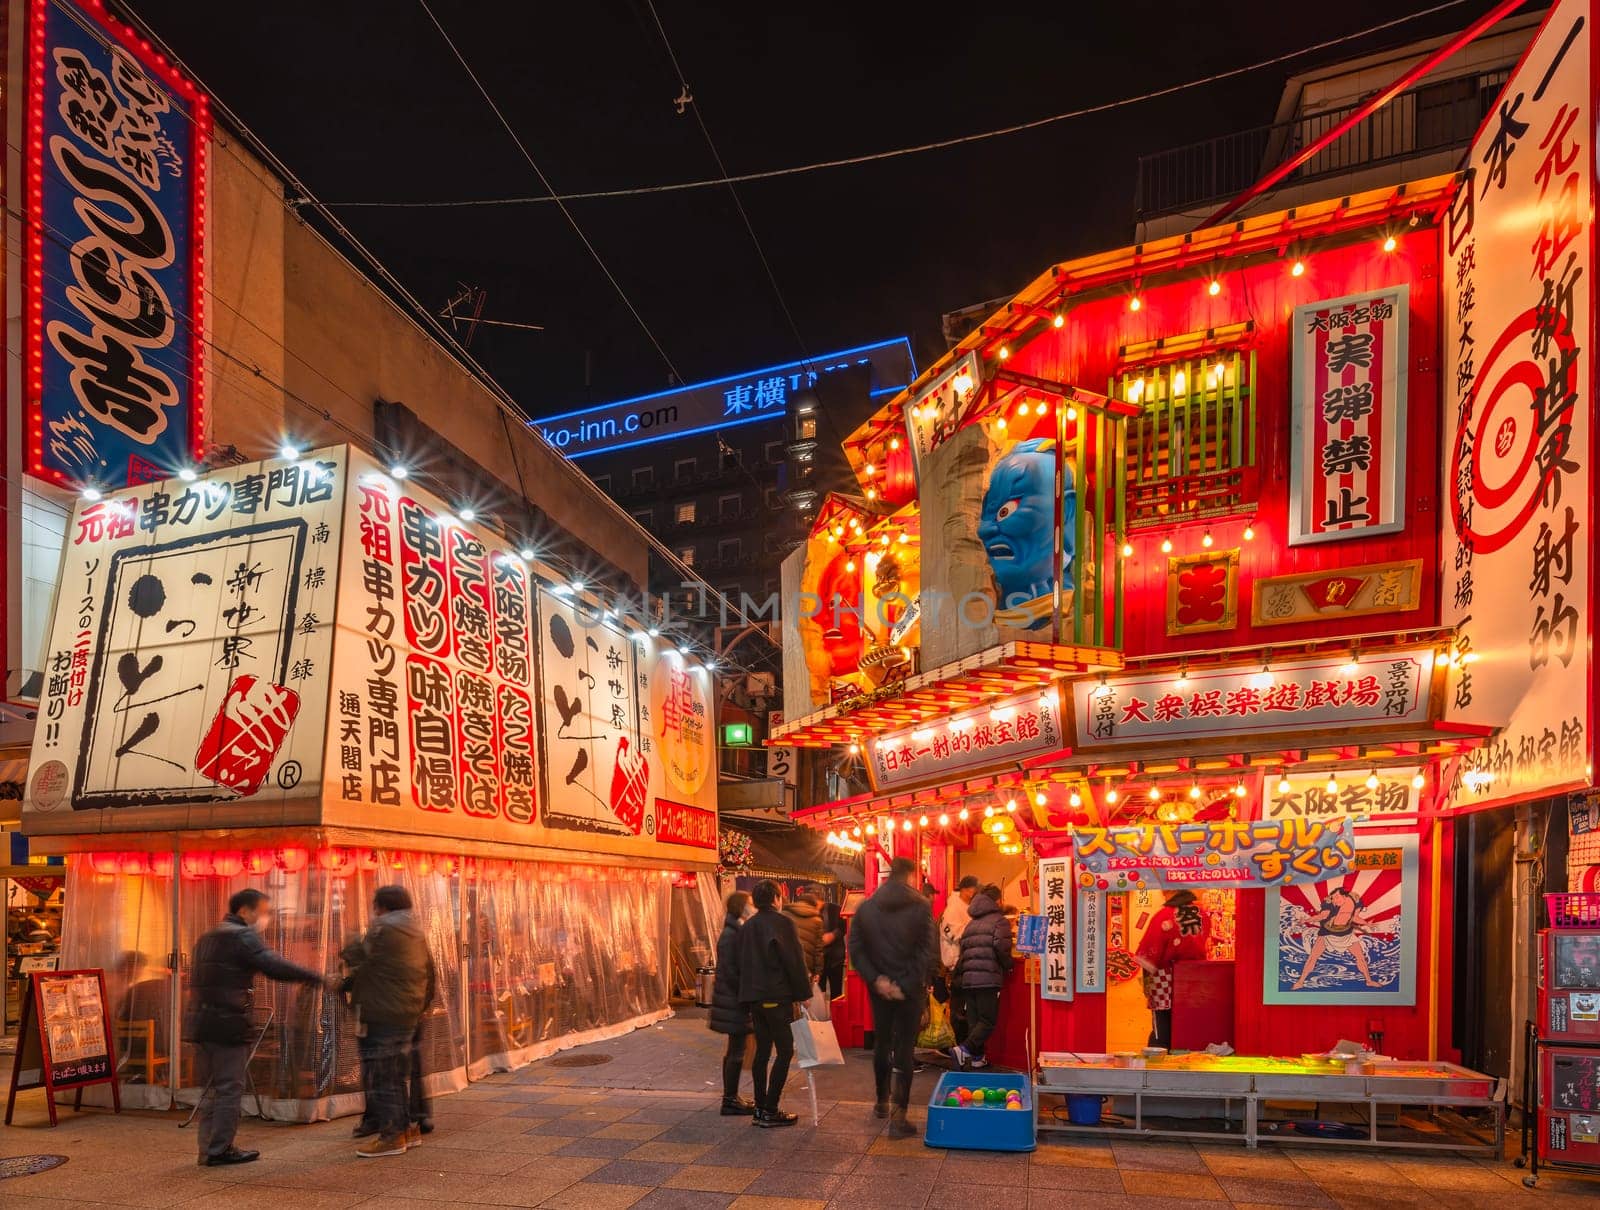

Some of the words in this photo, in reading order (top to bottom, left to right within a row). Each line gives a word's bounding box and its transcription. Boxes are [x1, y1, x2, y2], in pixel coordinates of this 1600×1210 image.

[47, 135, 180, 445] つり吉
[1307, 304, 1393, 334] 大阪名物
[1323, 333, 1373, 527] 実弾禁止
[75, 461, 336, 546] 元祖串カツ専門店
[67, 557, 99, 707] ソースの二度付け
[214, 561, 273, 671] 新世界
[291, 521, 330, 682] 商標登録
[401, 507, 447, 650] 串カツ
[452, 531, 489, 669] どて焼き
[494, 557, 528, 684] 大阪名物
[358, 485, 401, 806] 元祖串カツ専門店
[1120, 675, 1381, 725] 大衆娯楽遊戯場
[1383, 660, 1409, 717] 景品付
[340, 689, 362, 802] 通天閣店
[410, 664, 456, 808] 味自慢
[459, 673, 499, 814] 焼きそば
[502, 689, 535, 820] たこ焼き
[1270, 782, 1410, 816] 大阪名物
[1253, 840, 1354, 881] すくい
[1047, 877, 1067, 982] 実弾禁止
